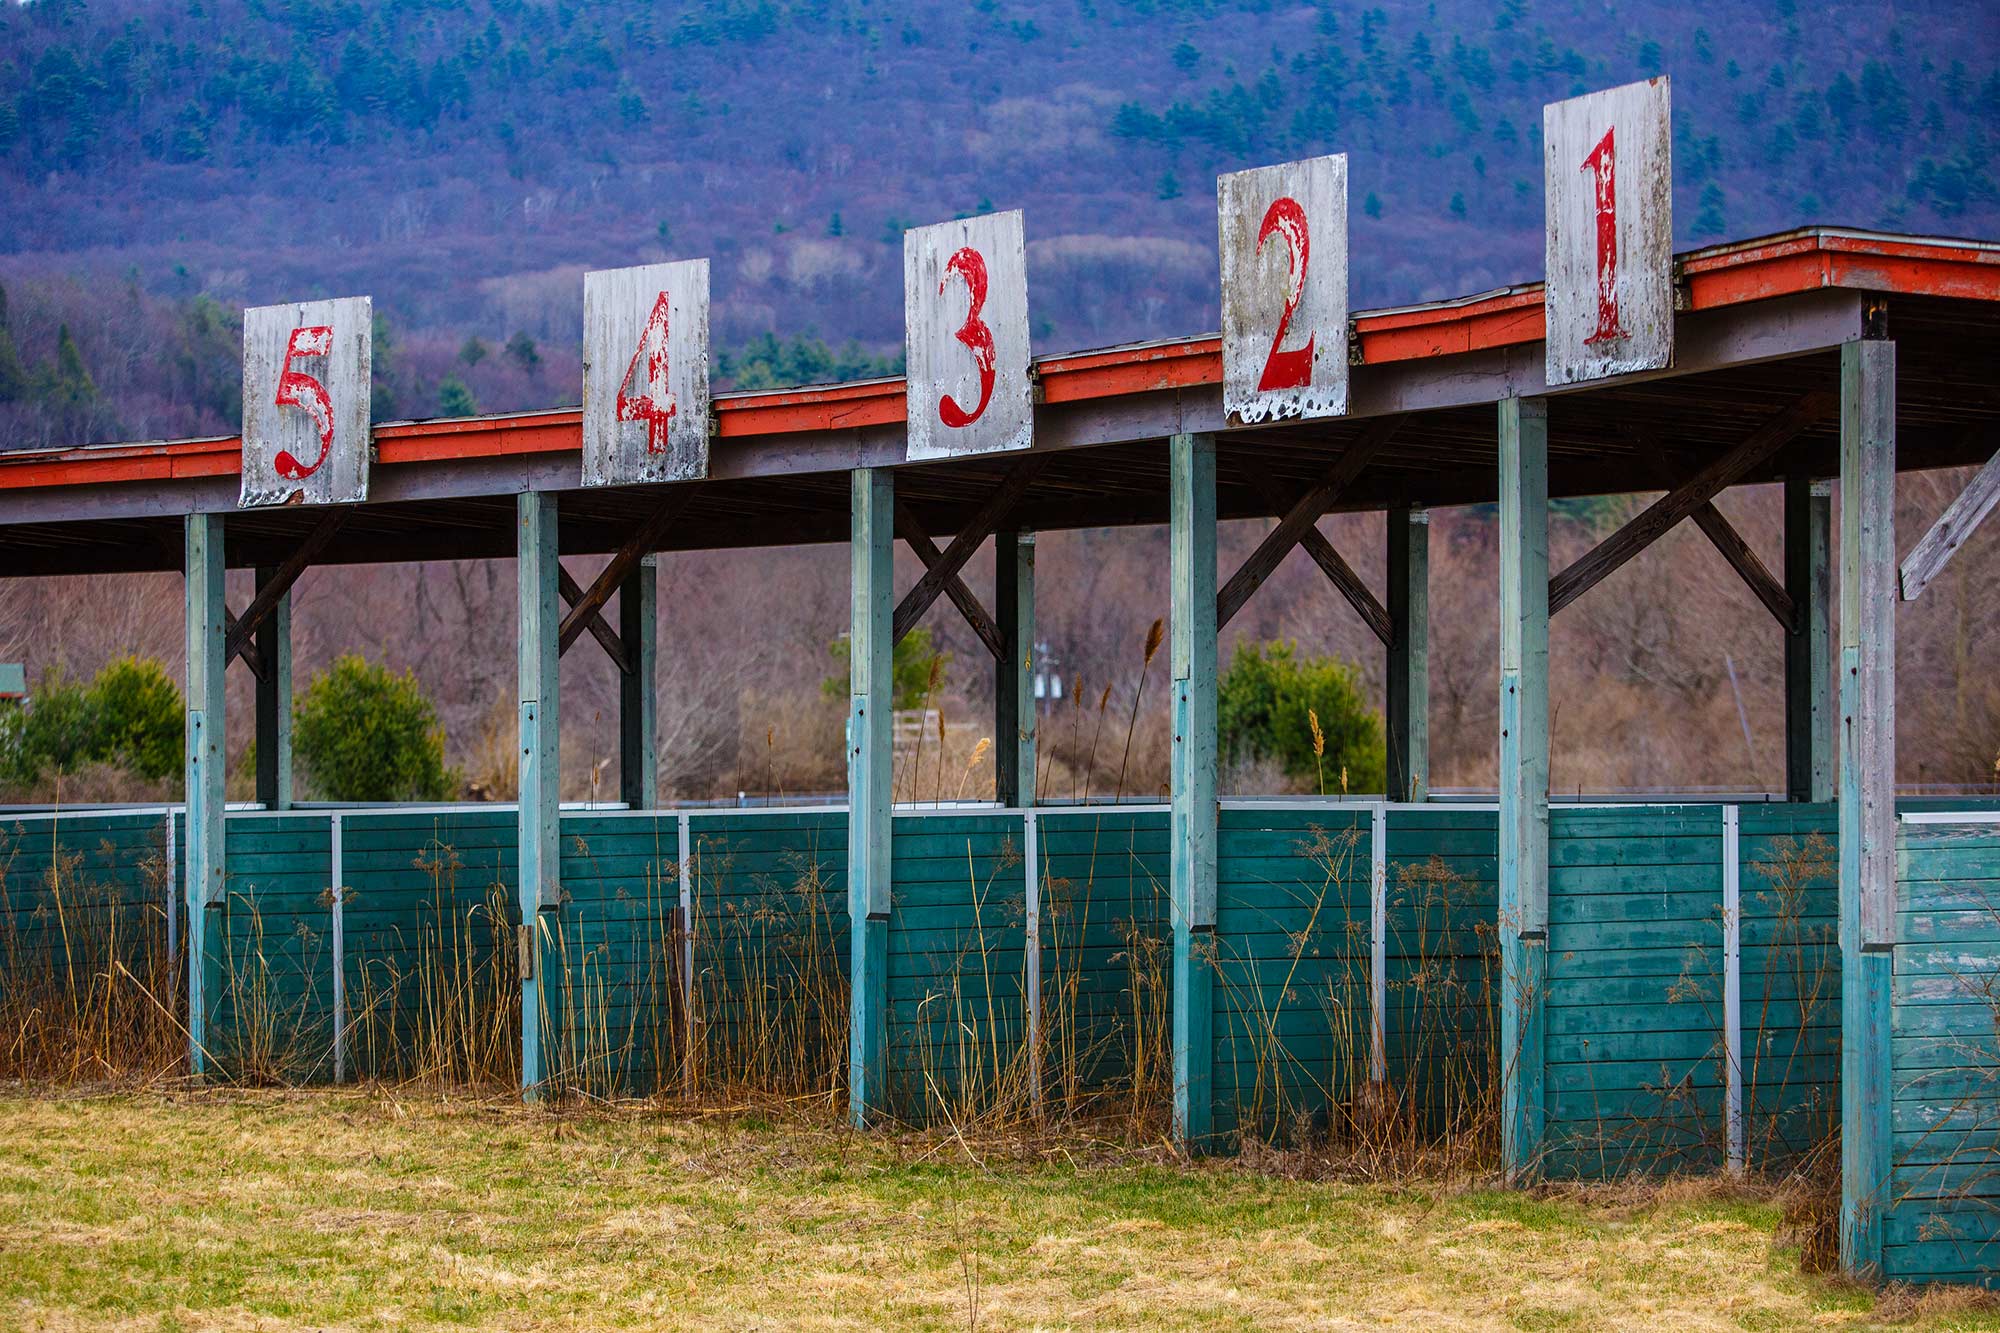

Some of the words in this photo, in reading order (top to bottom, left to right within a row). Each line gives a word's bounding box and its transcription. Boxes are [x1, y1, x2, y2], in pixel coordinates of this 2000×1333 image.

[1256, 197, 1315, 392] 2
[1580, 125, 1632, 345] 1
[275, 325, 334, 480] 5
[617, 291, 677, 455] 4
[939, 246, 996, 428] 3
